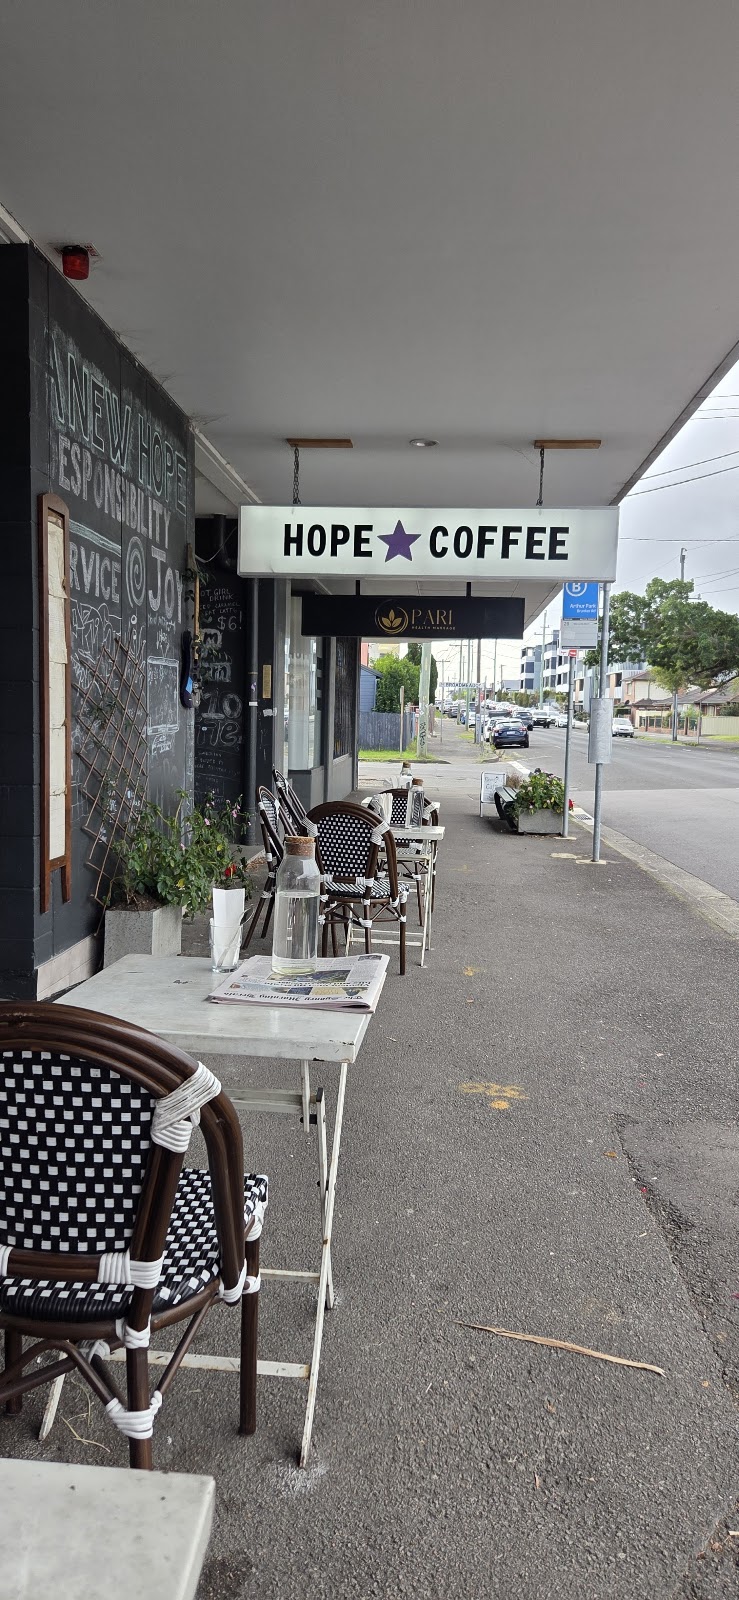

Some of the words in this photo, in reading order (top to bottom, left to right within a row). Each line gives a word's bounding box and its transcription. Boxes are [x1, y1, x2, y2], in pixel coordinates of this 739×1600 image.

[67, 352, 132, 473] NEW
[138, 412, 187, 518] HOPE
[283, 523, 373, 558] HOPE
[429, 525, 570, 560] COFFEE
[70, 541, 121, 604] RVICE
[210, 594, 234, 602] DRINK
[214, 588, 231, 596] GIRL
[411, 609, 453, 625] PARI
